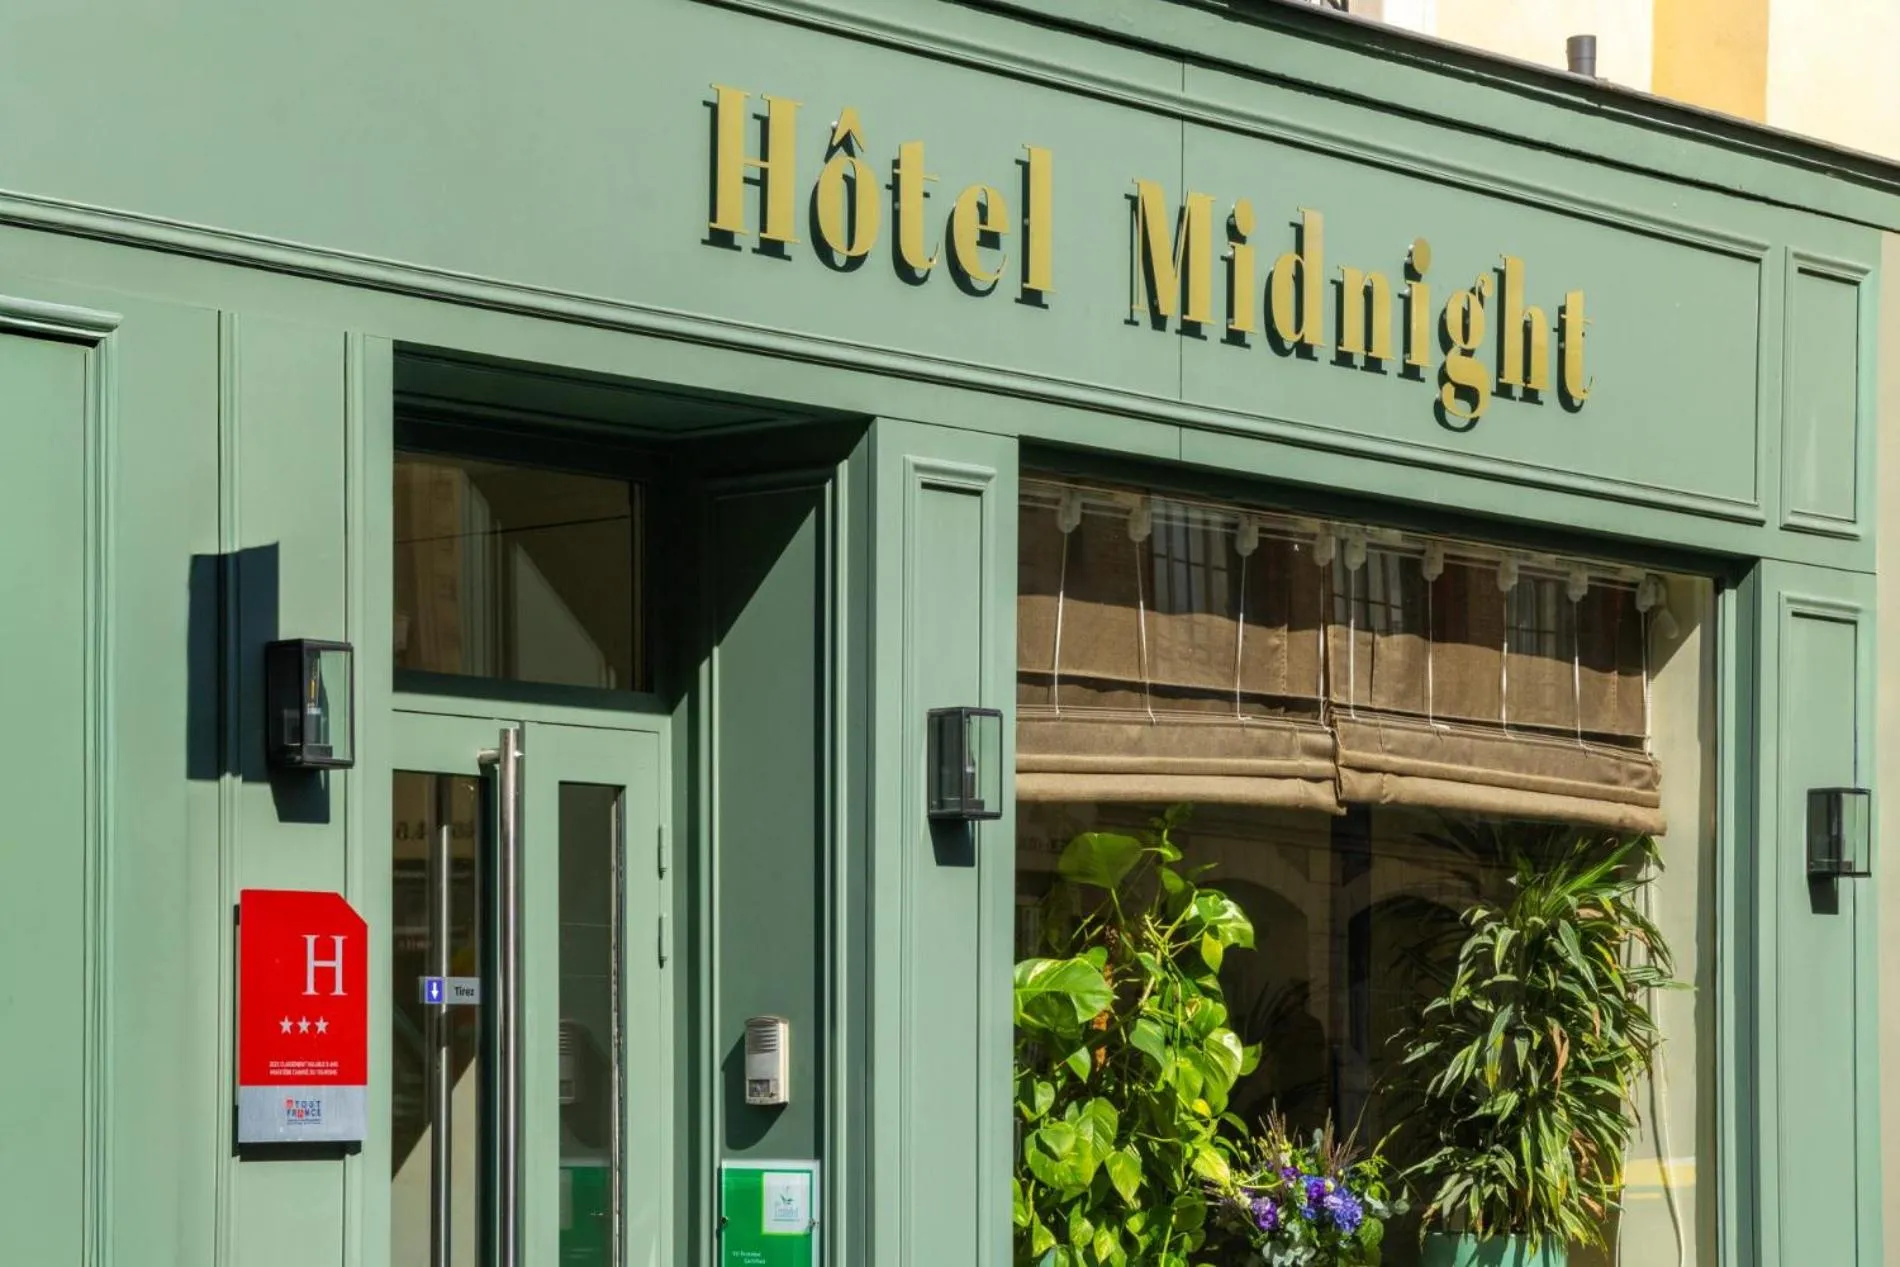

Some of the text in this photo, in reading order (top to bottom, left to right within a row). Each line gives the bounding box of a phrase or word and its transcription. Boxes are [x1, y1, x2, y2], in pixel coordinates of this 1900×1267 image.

[709, 83, 1594, 419] Hôtel Midnight
[301, 934, 348, 996] H
[454, 986, 475, 997] Tirez
